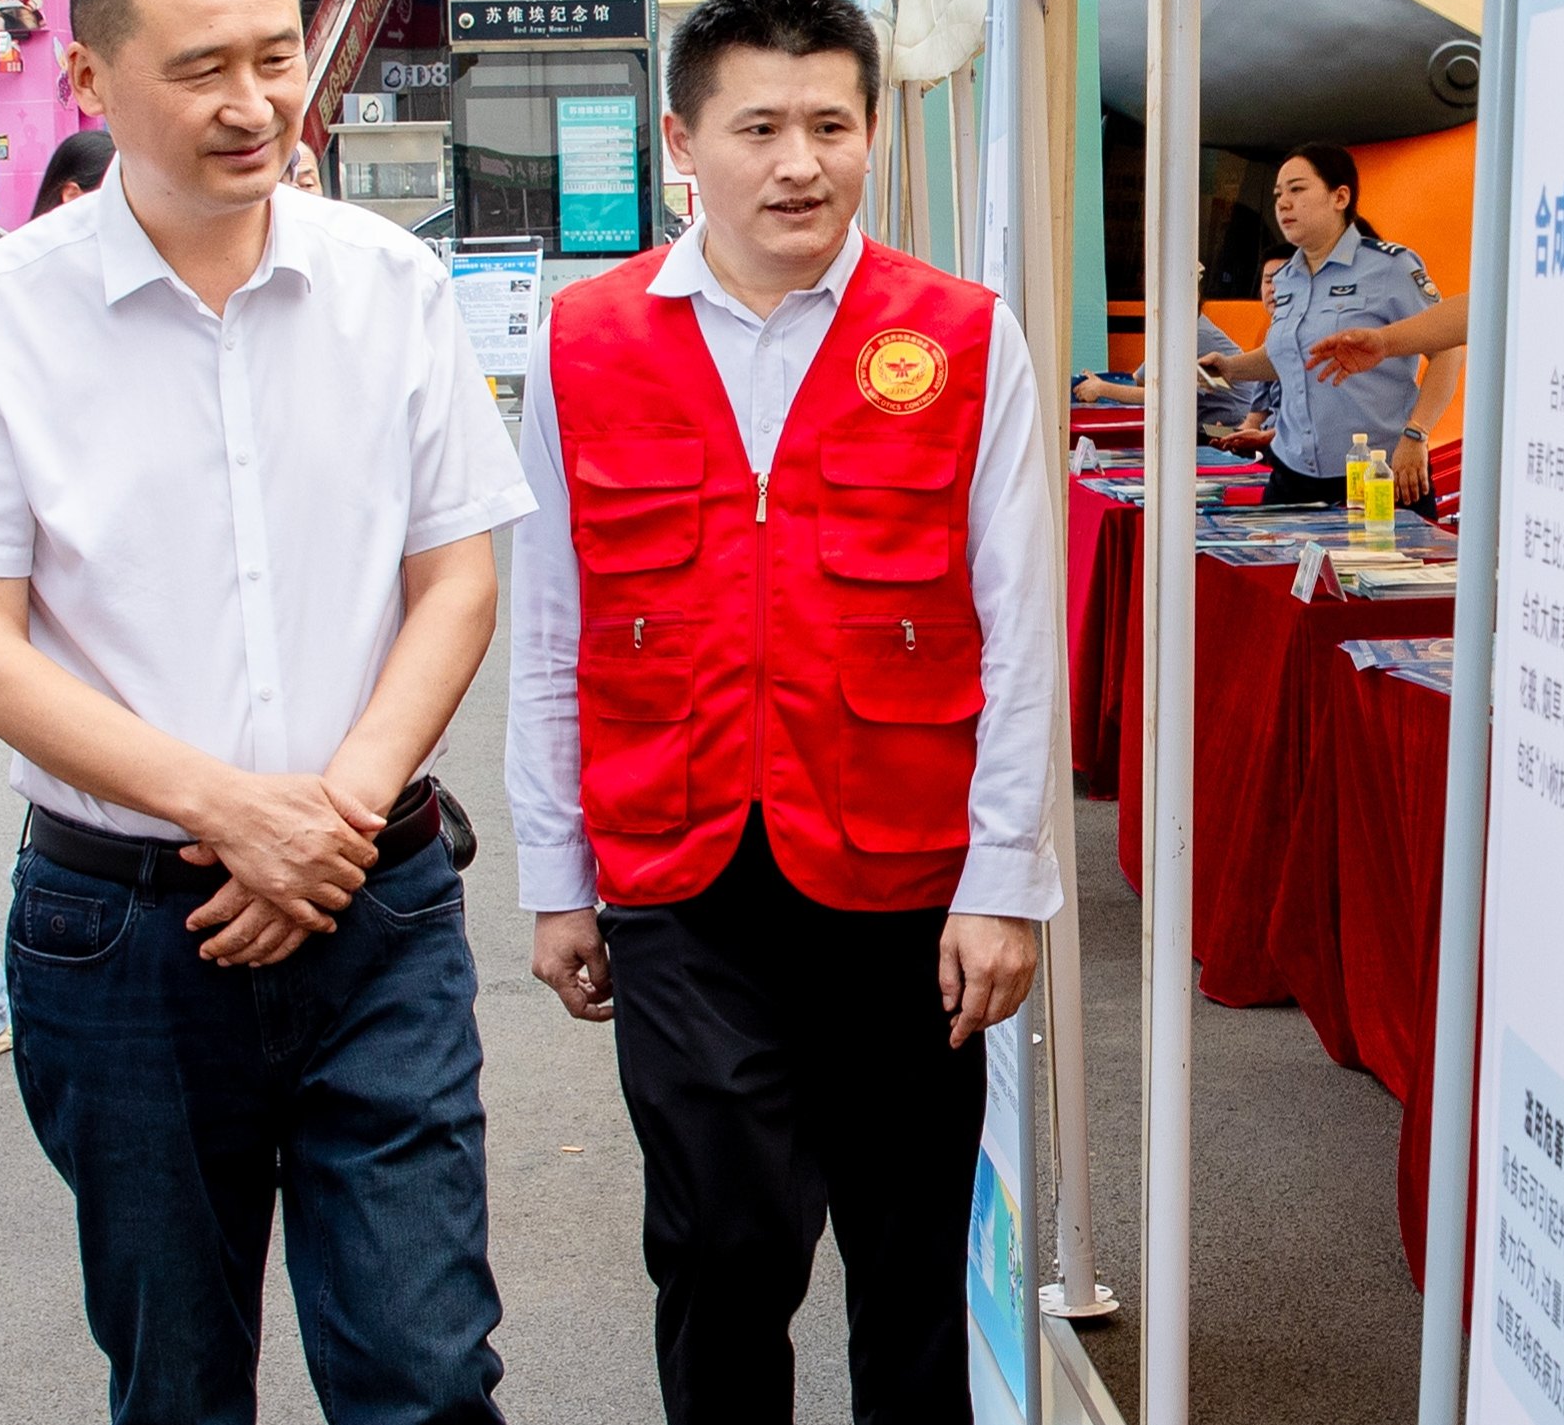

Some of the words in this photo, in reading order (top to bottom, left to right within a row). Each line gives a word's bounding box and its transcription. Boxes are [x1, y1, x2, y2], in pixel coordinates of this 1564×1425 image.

[486, 5, 610, 24] 苏维埃纪念馆
